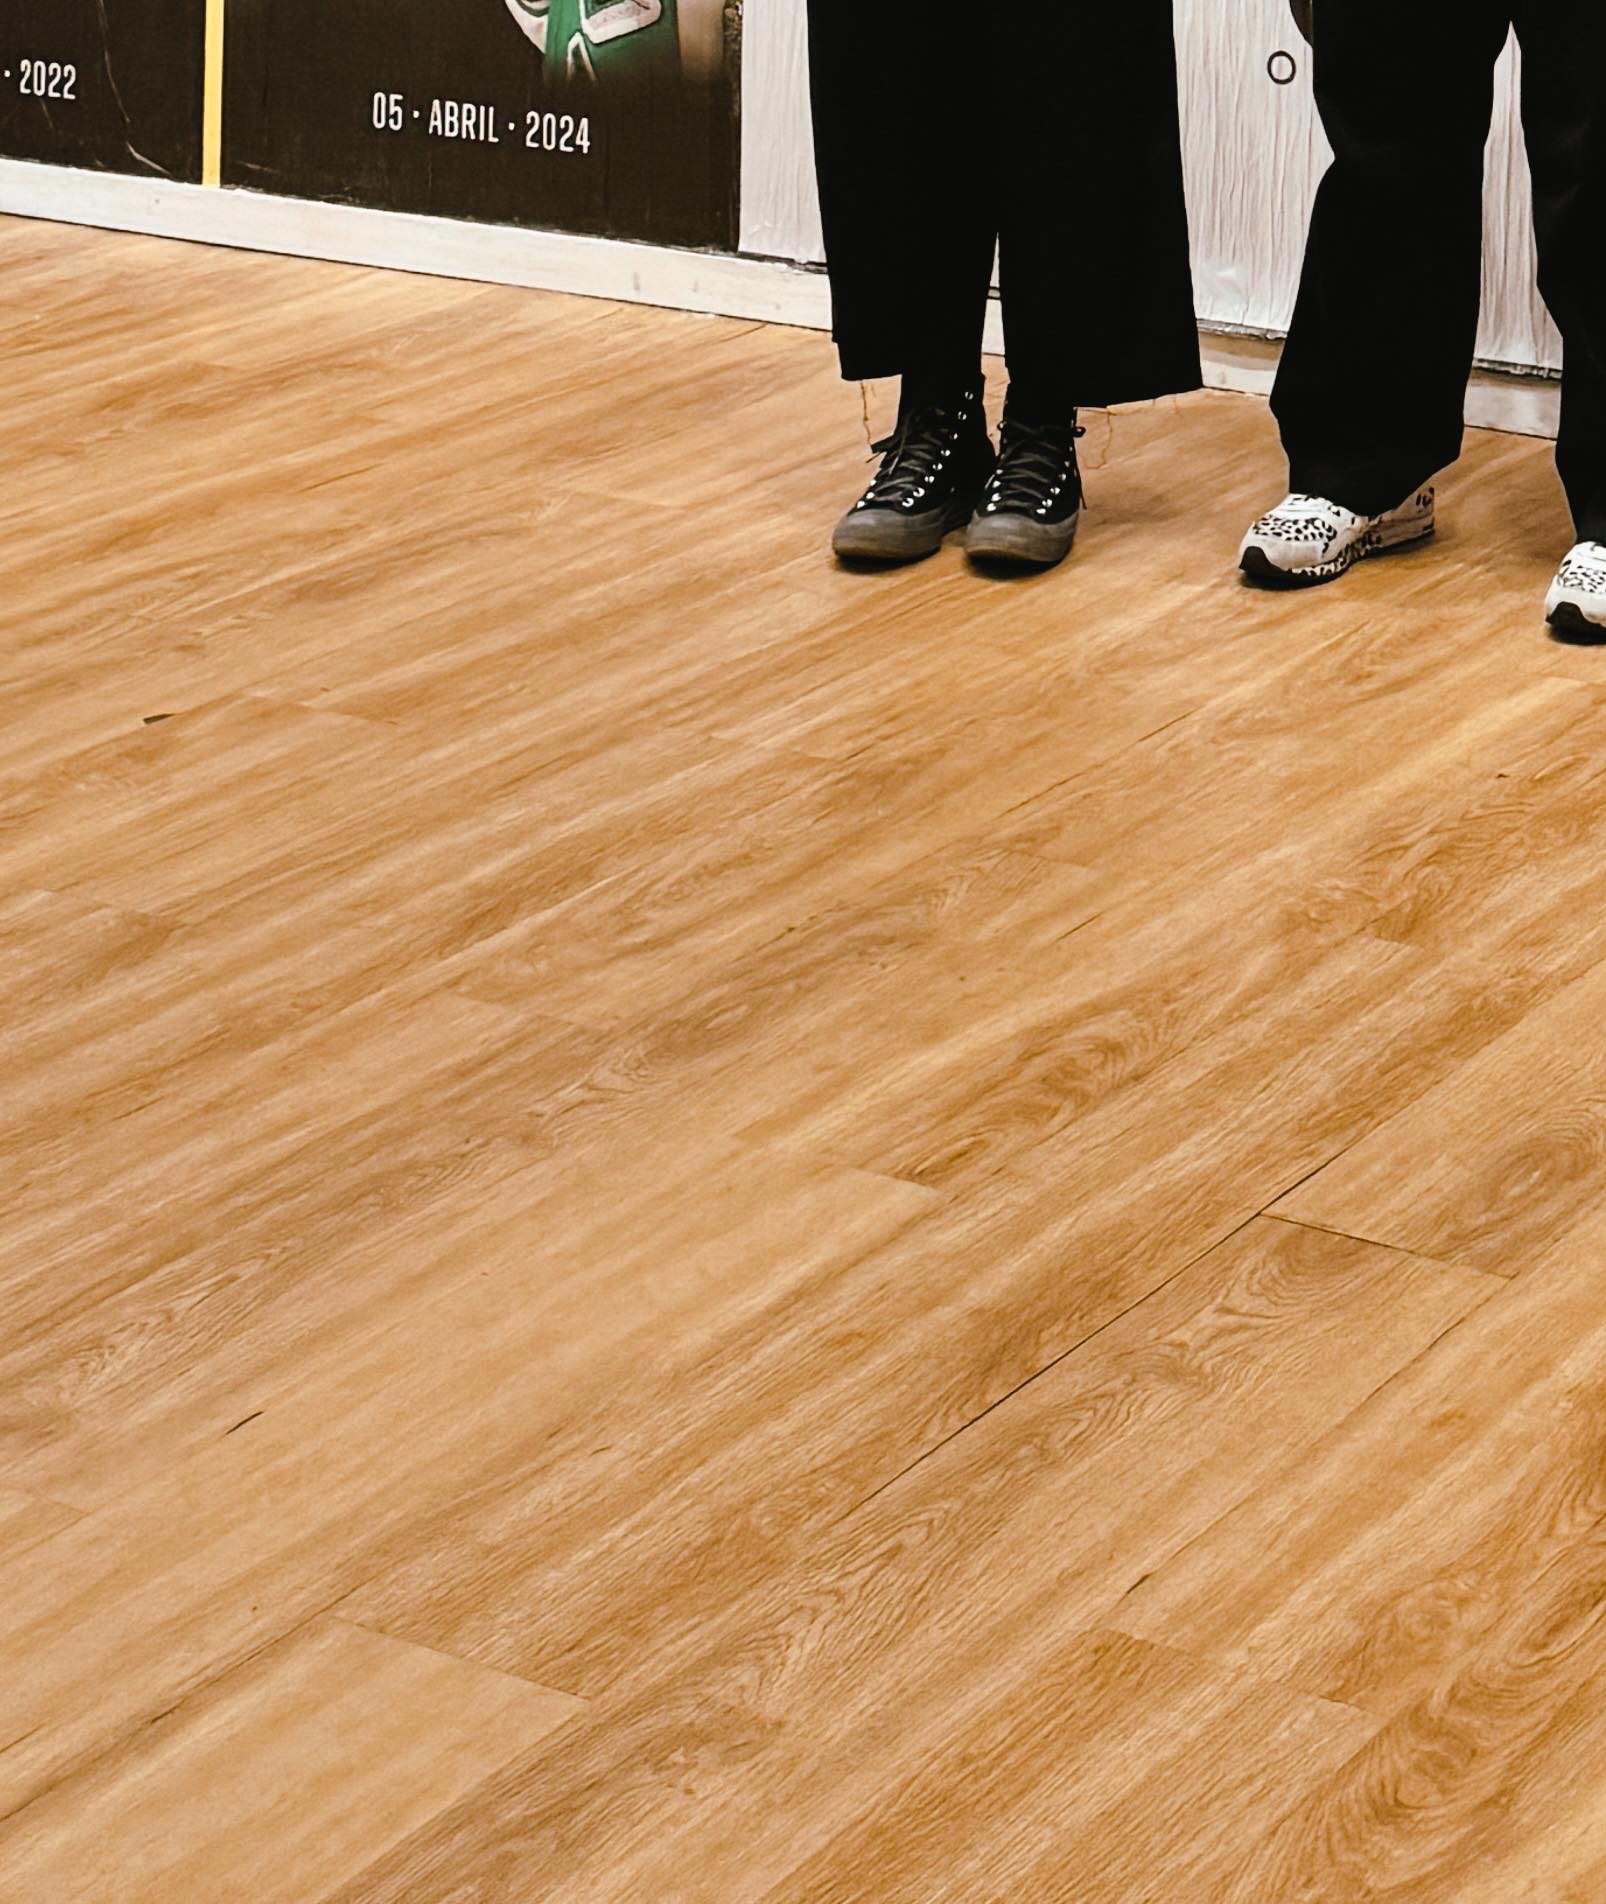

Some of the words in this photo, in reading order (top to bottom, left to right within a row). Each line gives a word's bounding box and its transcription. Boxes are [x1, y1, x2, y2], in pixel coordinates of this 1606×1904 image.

[19, 59, 77, 100] 2022
[372, 92, 404, 132] 05
[428, 99, 500, 143] ABRIL
[525, 110, 591, 154] 2024
